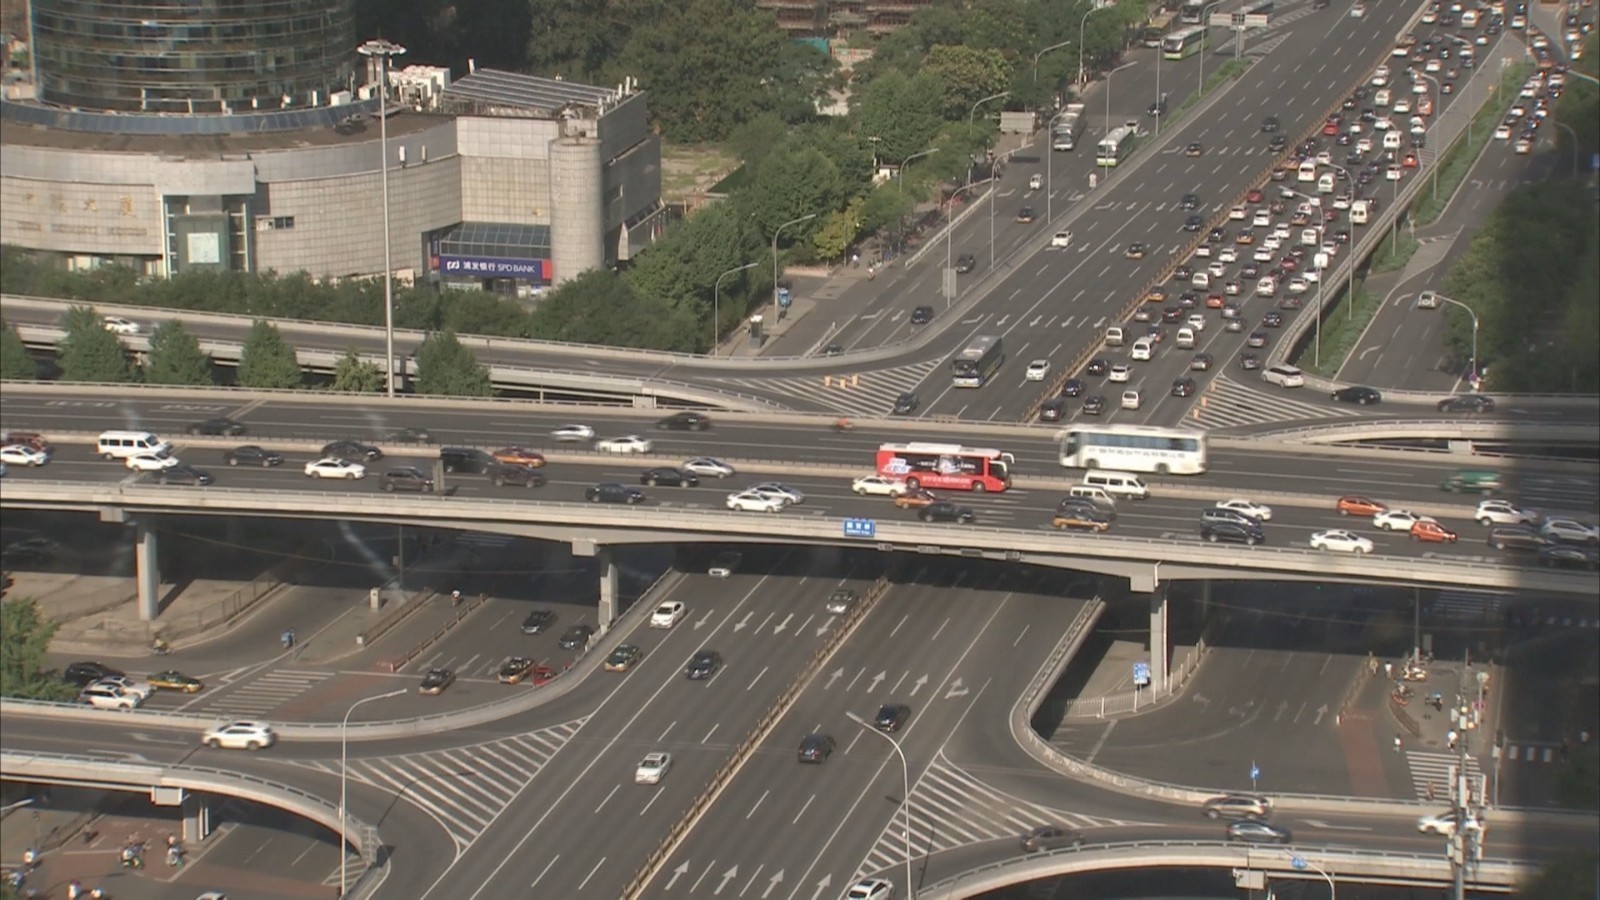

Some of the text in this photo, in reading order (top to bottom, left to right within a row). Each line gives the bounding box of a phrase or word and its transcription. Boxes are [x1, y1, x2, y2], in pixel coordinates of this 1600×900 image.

[463, 261, 535, 273] 浦发银行 SPD BANK
